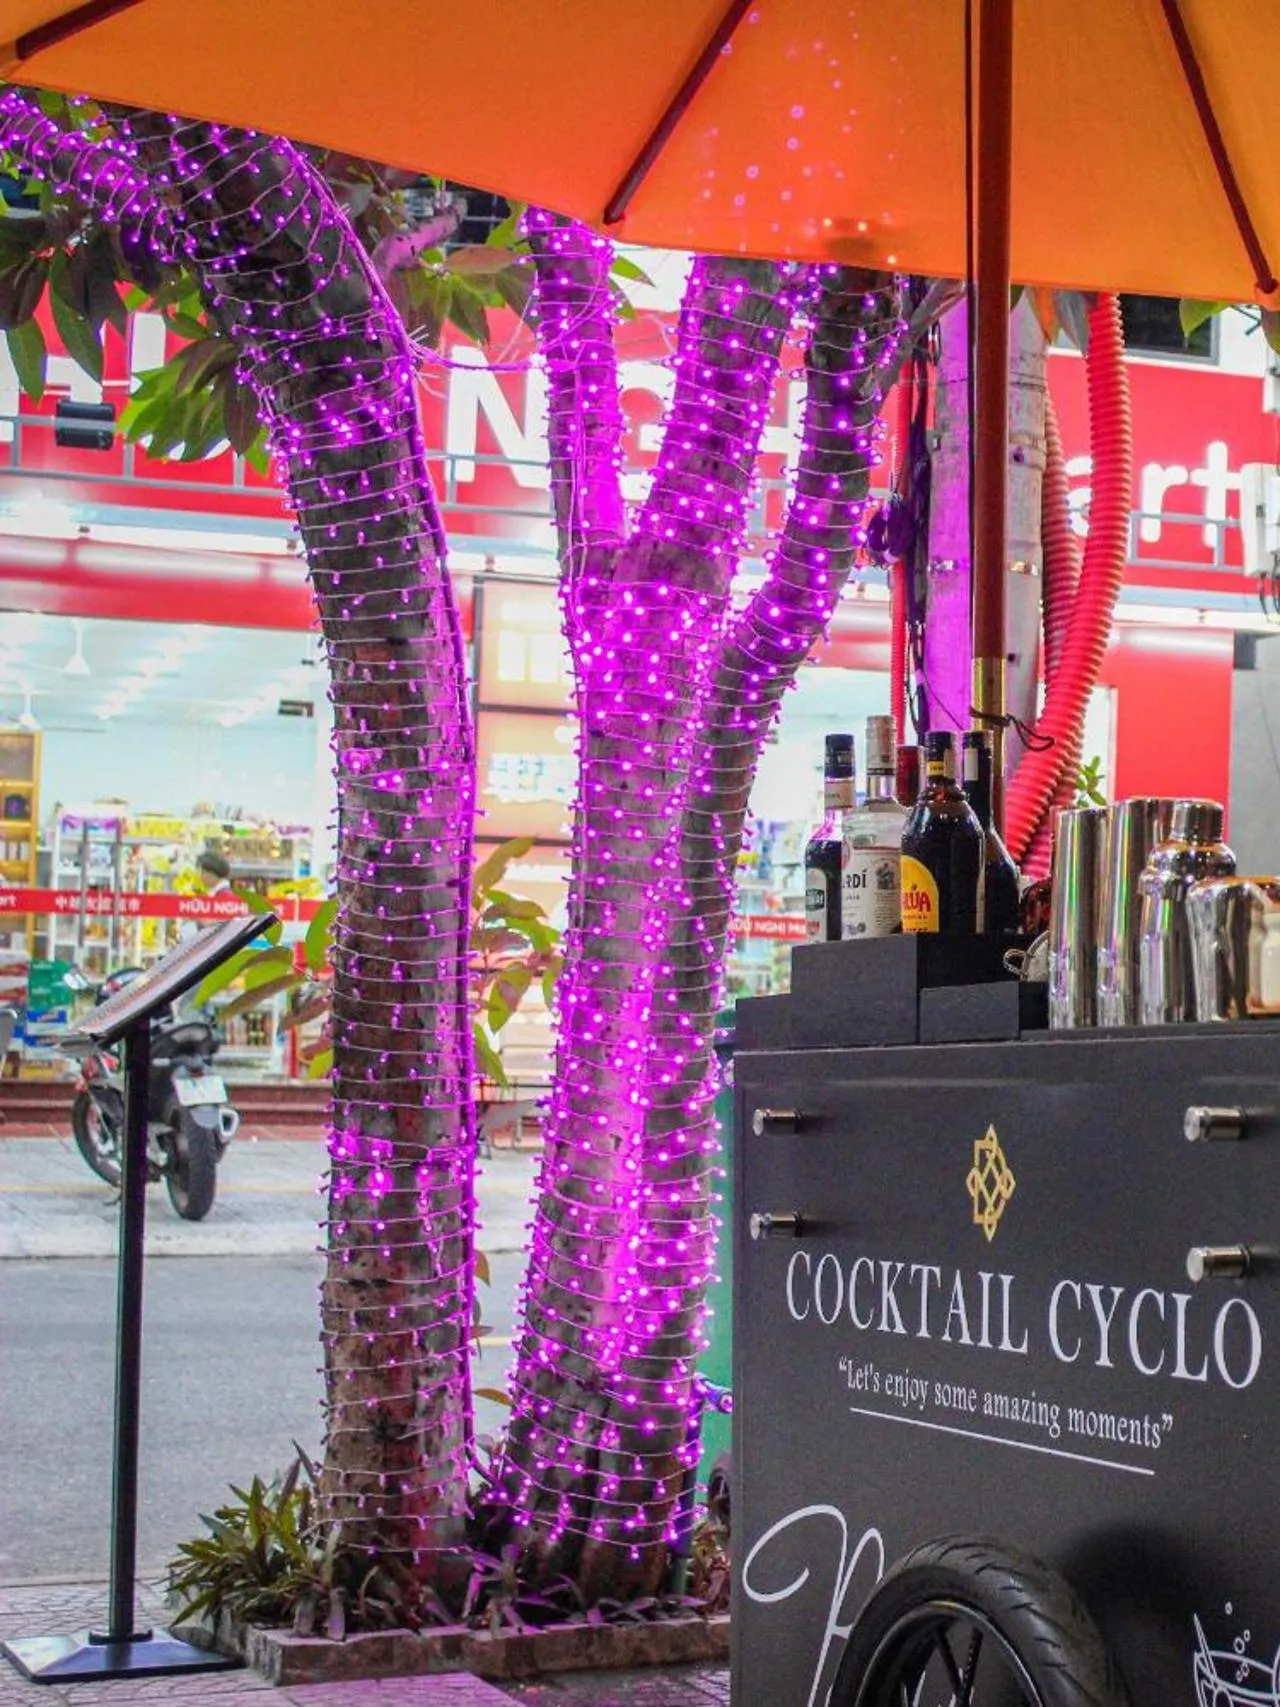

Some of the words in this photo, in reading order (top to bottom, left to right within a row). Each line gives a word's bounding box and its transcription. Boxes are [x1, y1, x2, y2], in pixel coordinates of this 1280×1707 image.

[842, 868, 867, 889] RDÍ
[786, 1250, 1029, 1355] COCKTAIL
[1048, 1279, 1263, 1389] CYCLO
[884, 1368, 929, 1411] enjoy
[934, 1382, 977, 1413] some
[983, 1391, 1061, 1439] amazing
